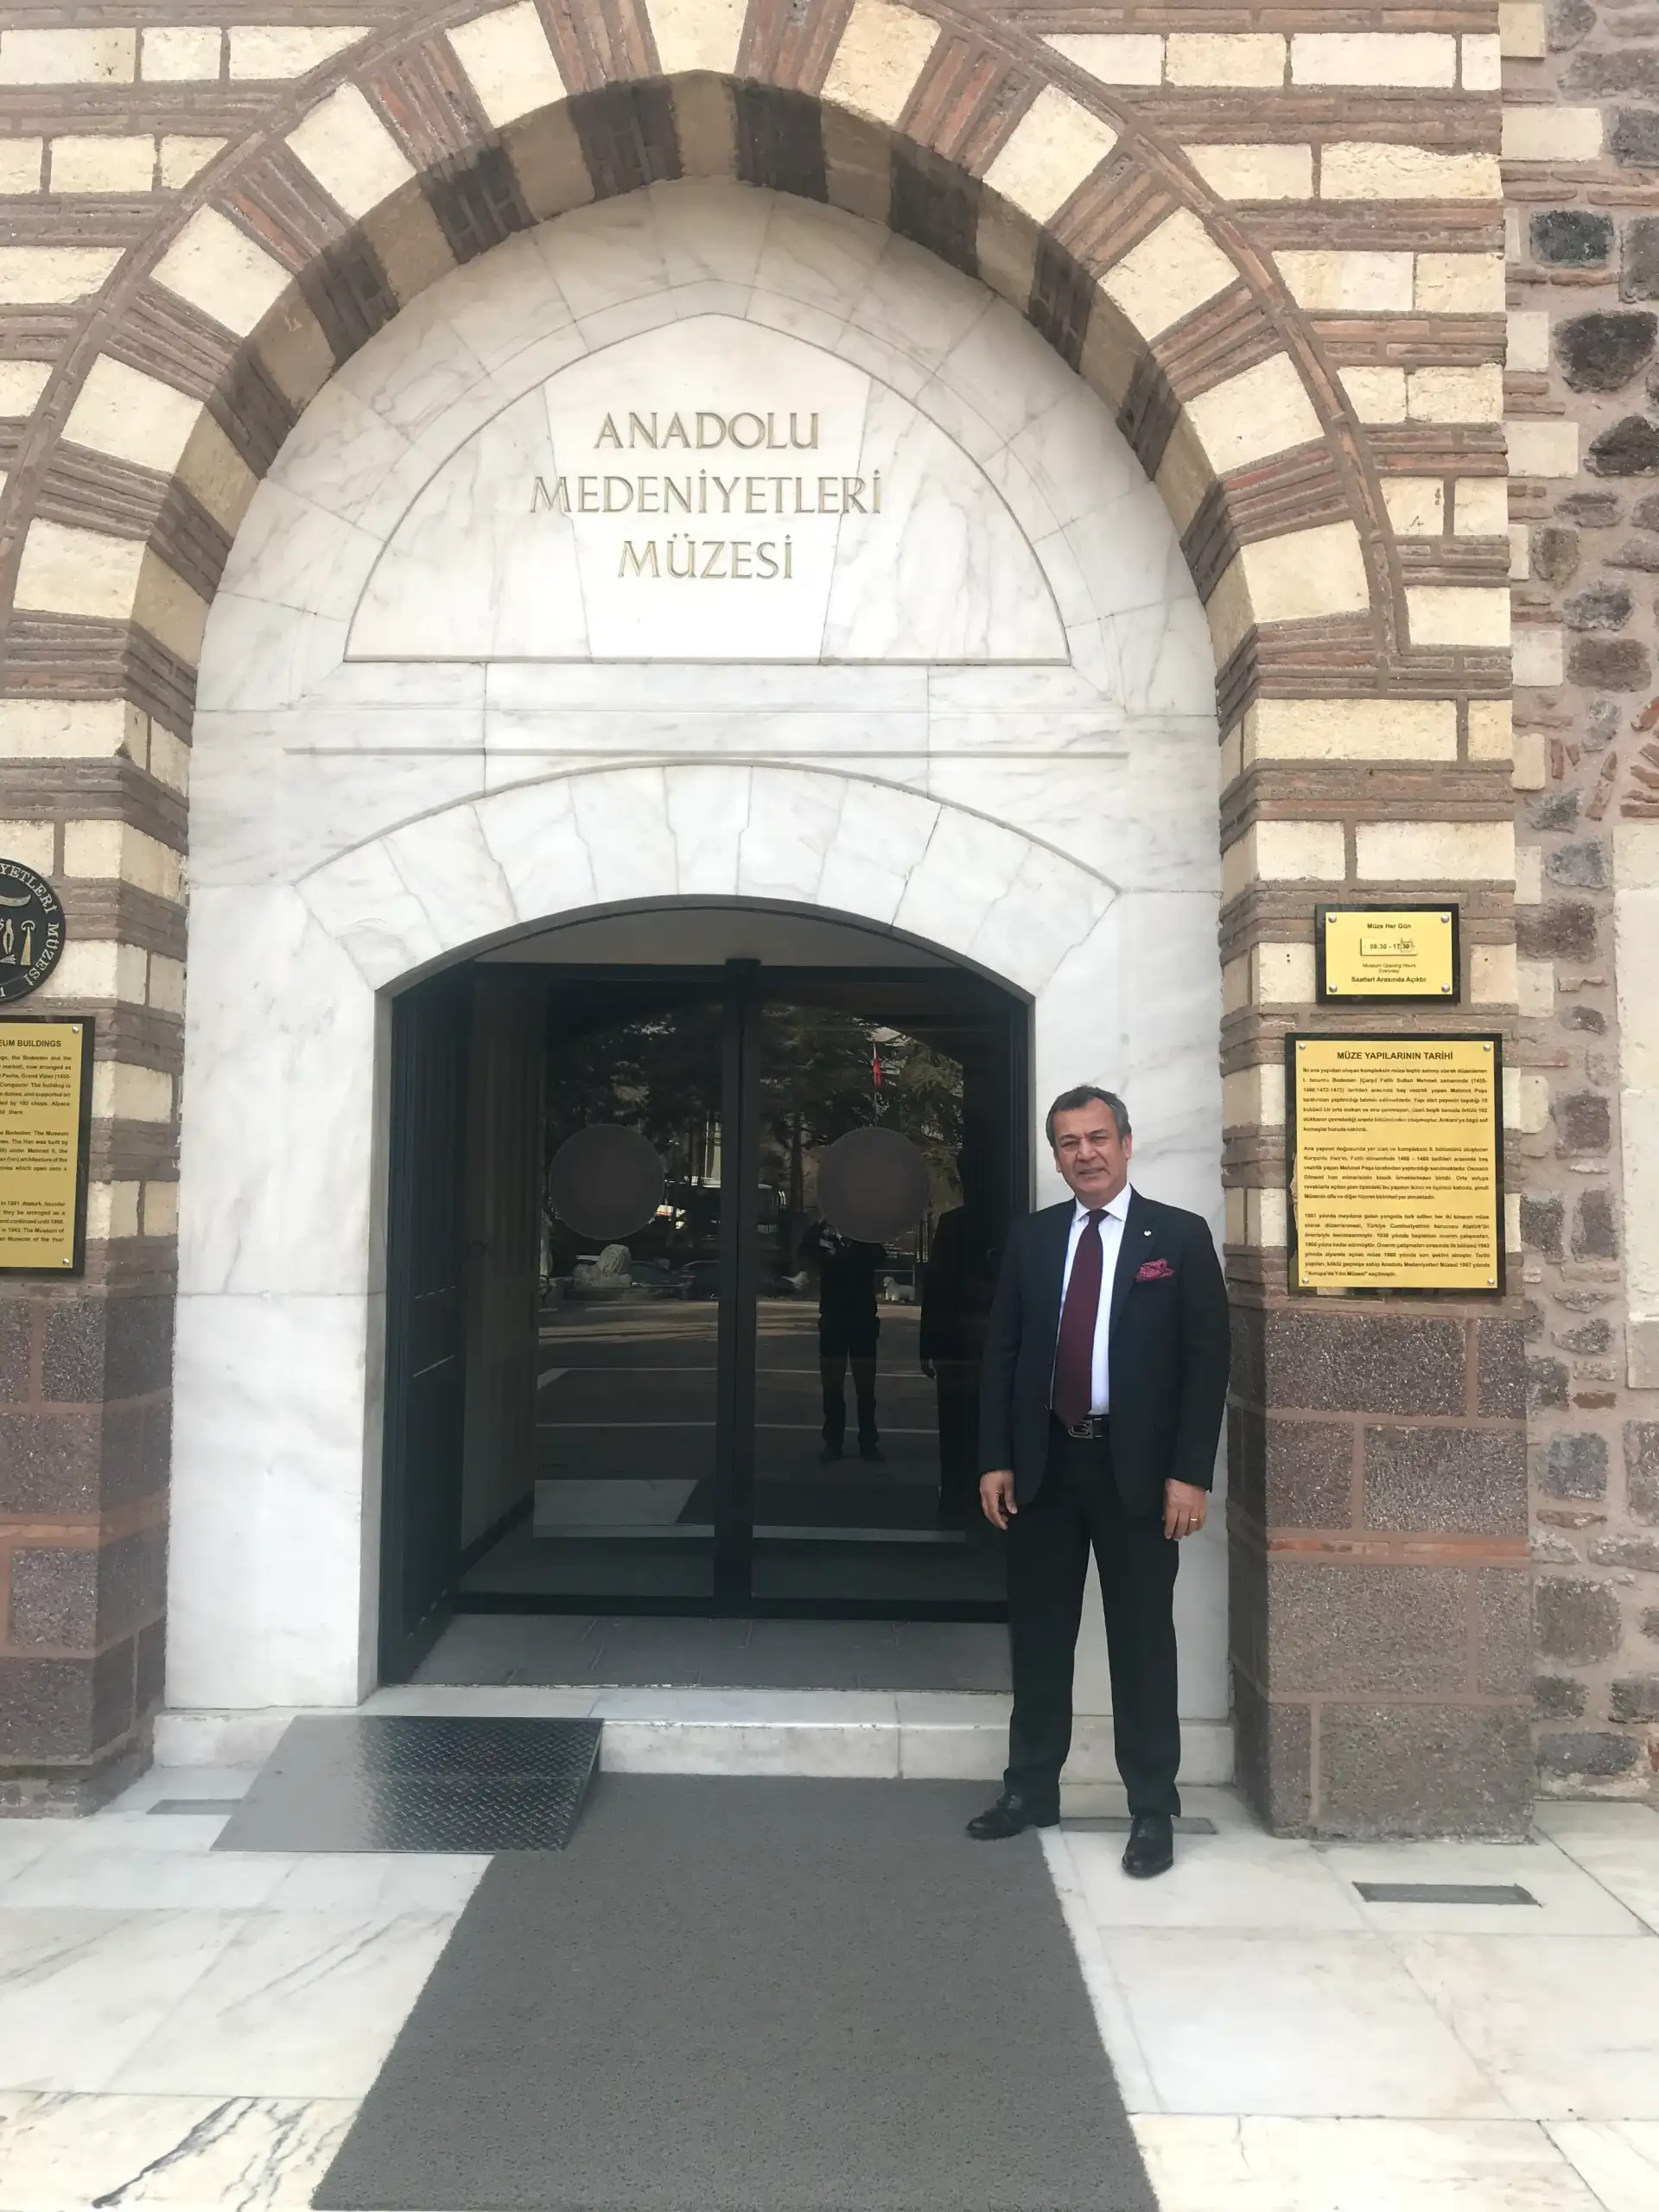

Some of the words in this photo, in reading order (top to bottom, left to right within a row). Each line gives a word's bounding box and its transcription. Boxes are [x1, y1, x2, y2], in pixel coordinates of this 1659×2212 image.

[594, 412, 819, 449] ANADOLU
[530, 469, 881, 514] MEDENİYETLERİ
[618, 533, 793, 579] MÜZESİ
